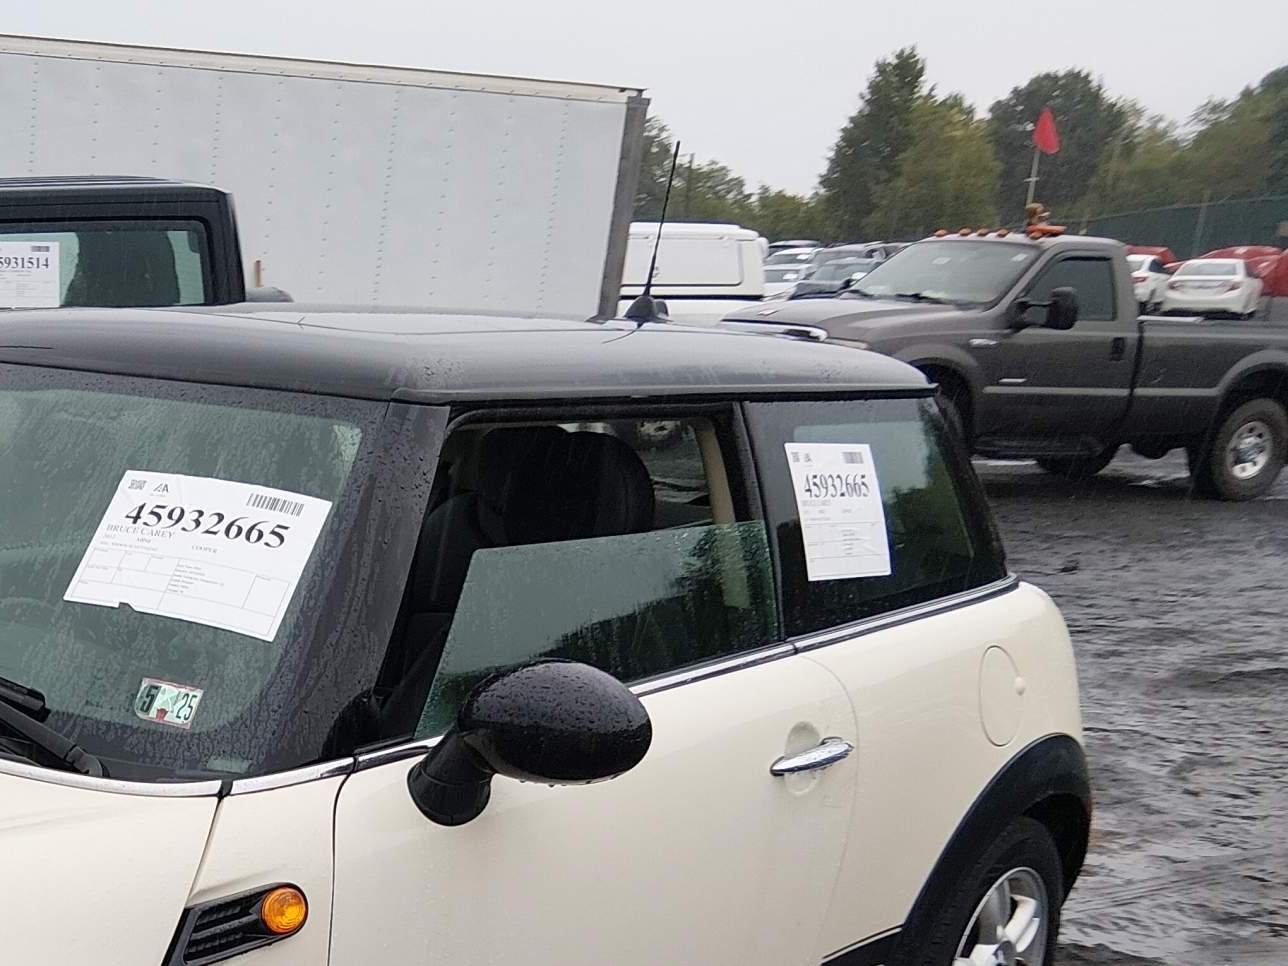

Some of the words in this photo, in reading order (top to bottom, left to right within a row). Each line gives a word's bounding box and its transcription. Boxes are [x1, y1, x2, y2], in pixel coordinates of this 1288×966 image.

[804, 474, 869, 498] 45932665
[125, 502, 291, 548] 45932665
[175, 692, 198, 720] 25
